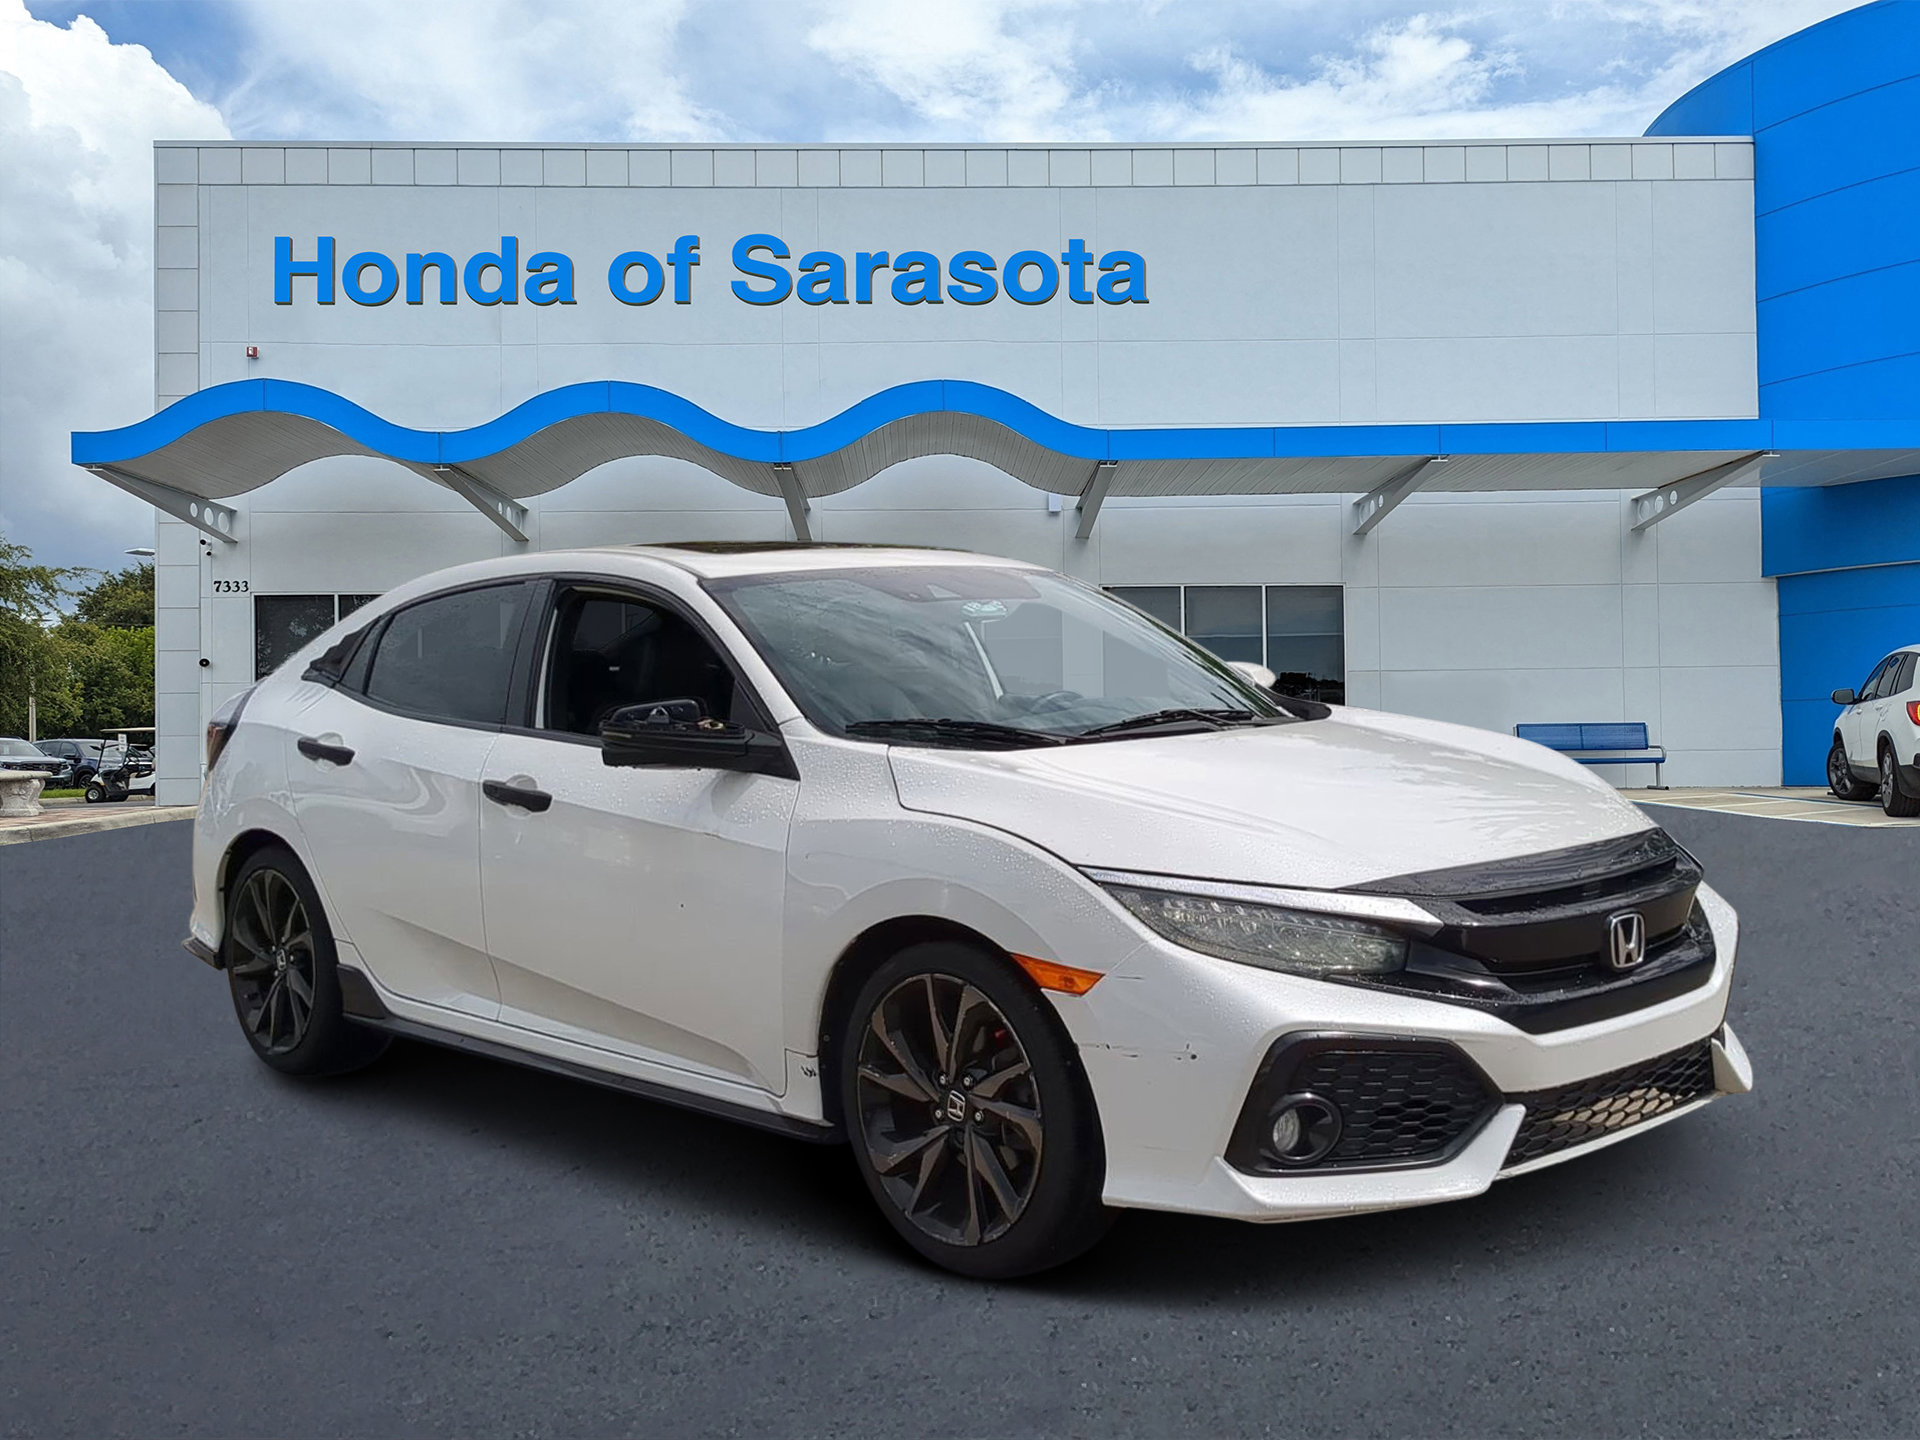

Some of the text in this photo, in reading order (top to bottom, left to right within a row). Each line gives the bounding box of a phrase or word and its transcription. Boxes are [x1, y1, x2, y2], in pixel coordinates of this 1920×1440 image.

[274, 234, 1149, 306] Honda of Sarasota
[213, 580, 249, 593] 7333
